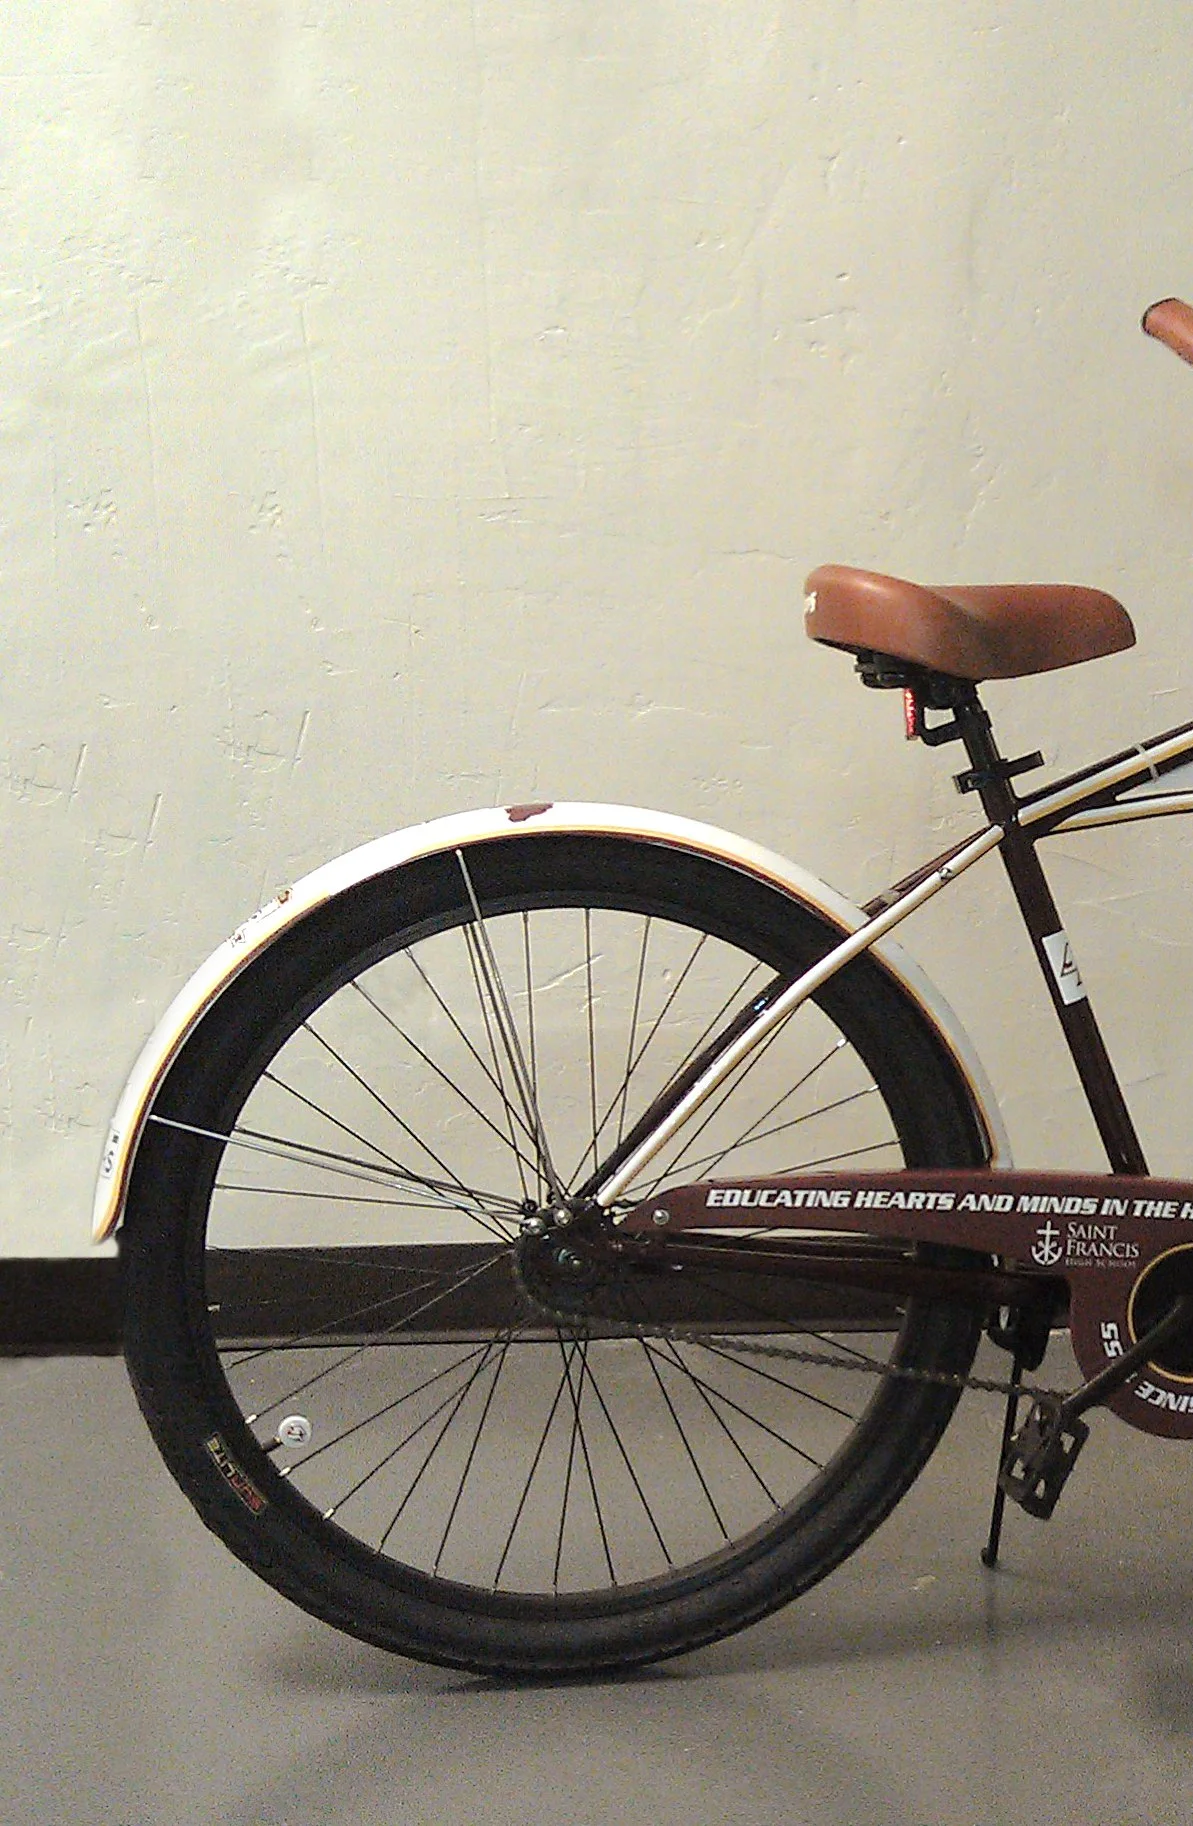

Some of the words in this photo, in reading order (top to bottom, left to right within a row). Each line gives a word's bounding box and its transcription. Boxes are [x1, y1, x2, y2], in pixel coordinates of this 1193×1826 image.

[705, 1188, 851, 1209] EDUCATING
[853, 1190, 956, 1211] HEARTS
[956, 1193, 1015, 1213] AND
[1015, 1195, 1099, 1216] MINDS
[1100, 1197, 1128, 1217] IN
[1132, 1199, 1179, 1219] THE
[1066, 1220, 1119, 1241] SAINT
[1066, 1239, 1140, 1259] FRANCIS
